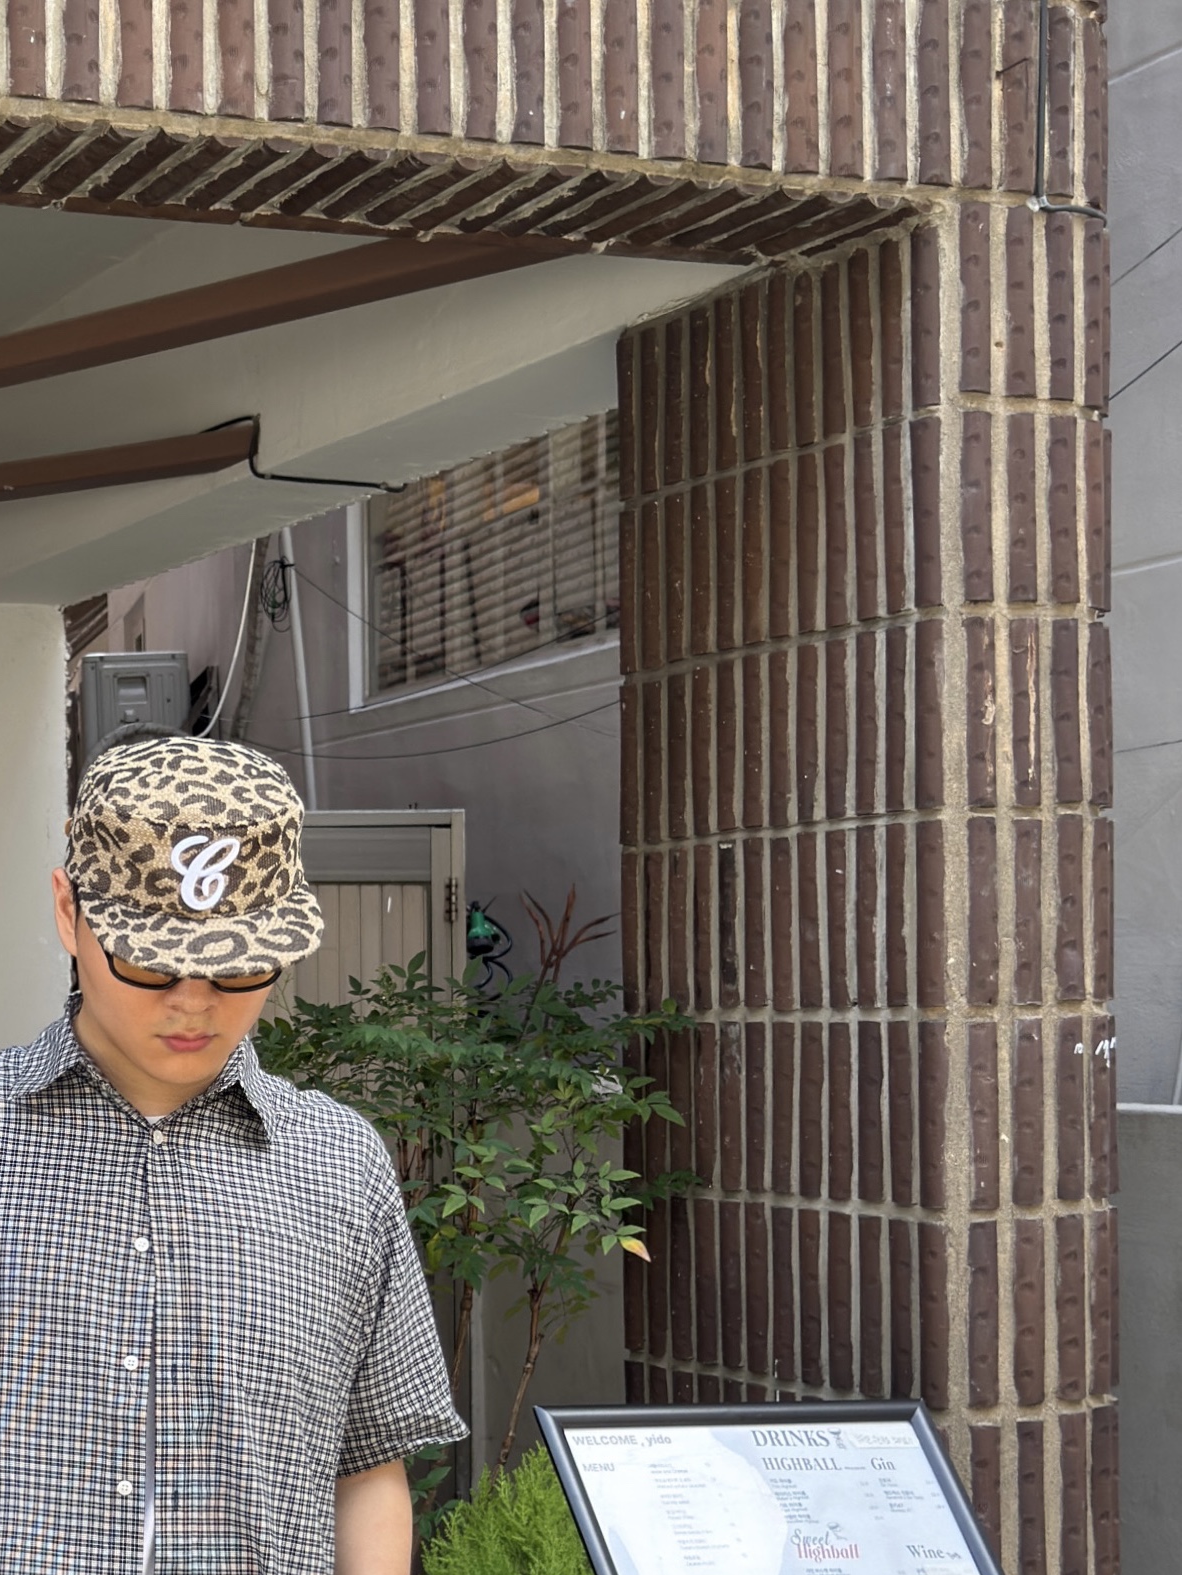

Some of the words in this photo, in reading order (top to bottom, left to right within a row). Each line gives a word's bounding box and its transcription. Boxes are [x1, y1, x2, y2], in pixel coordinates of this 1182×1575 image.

[572, 1435, 638, 1446] WELCOME
[751, 1429, 830, 1448] DRINKS
[582, 1462, 615, 1473] MENU
[761, 1456, 842, 1472] HIGHBALL
[870, 1456, 896, 1471] Gin
[790, 1528, 830, 1547] Sweet
[797, 1543, 859, 1563] Highball
[906, 1544, 946, 1559] Wine
